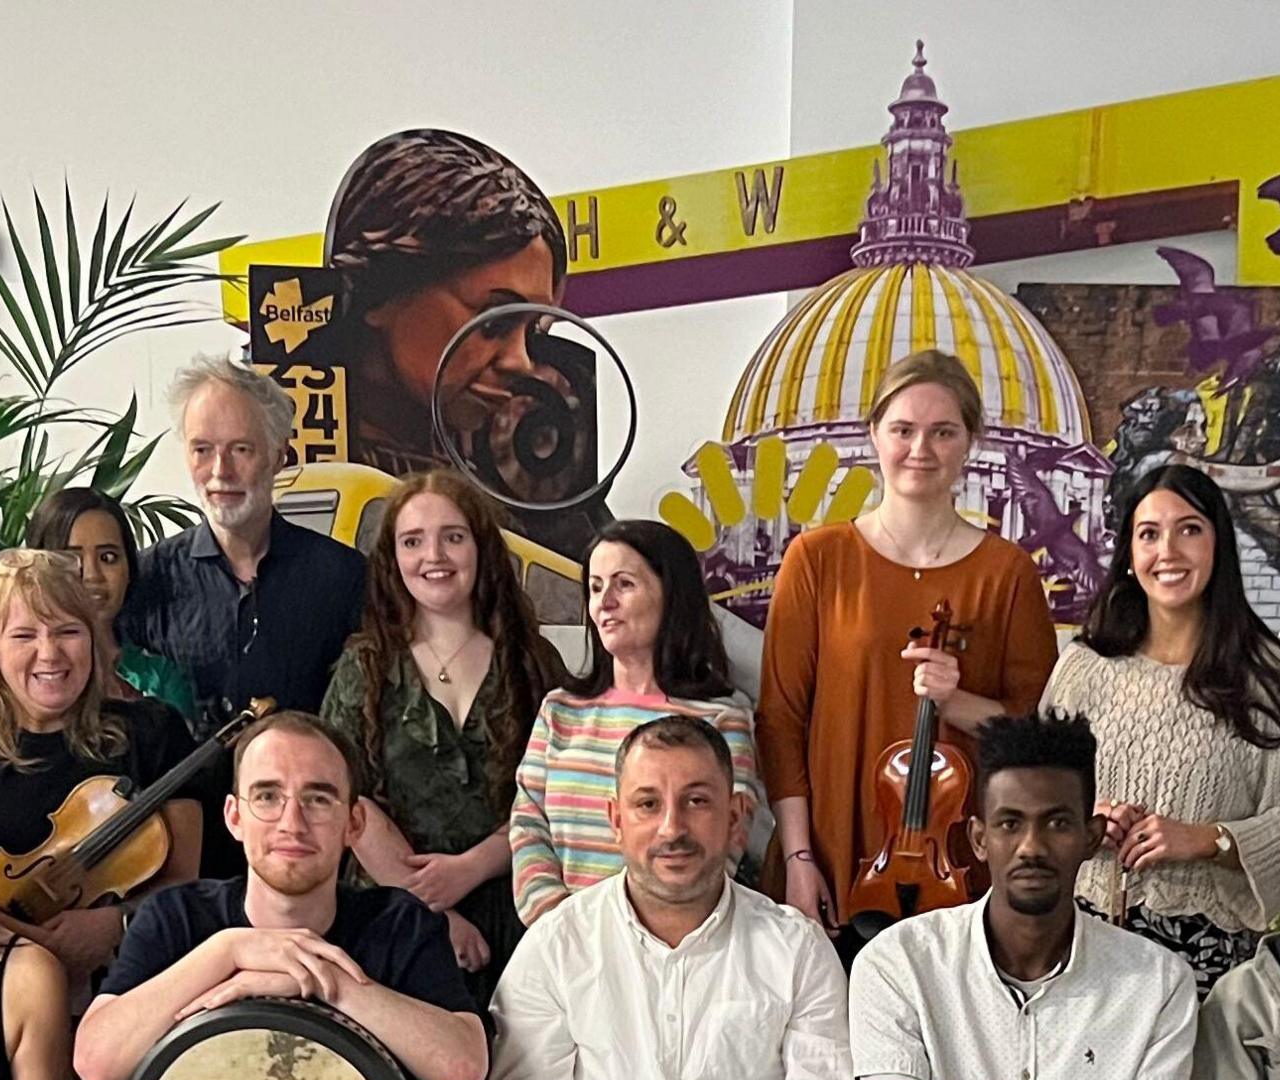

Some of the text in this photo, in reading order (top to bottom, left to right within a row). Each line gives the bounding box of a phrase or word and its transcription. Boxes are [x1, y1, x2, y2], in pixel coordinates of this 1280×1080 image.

[567, 166, 784, 261] H & W
[266, 304, 331, 323] Belfast
